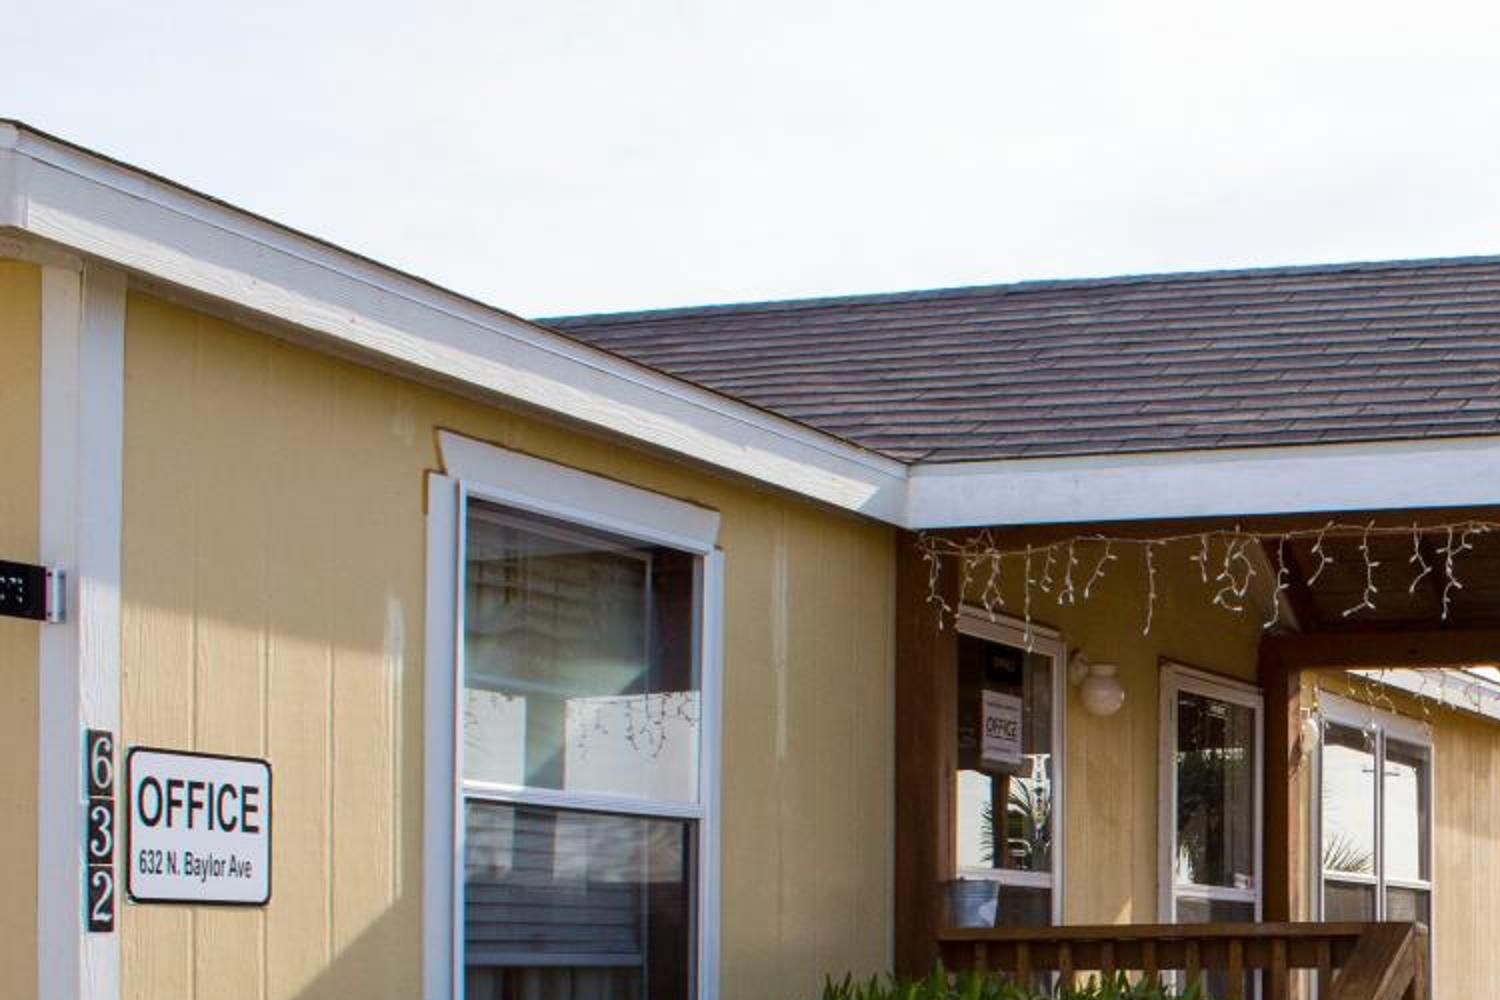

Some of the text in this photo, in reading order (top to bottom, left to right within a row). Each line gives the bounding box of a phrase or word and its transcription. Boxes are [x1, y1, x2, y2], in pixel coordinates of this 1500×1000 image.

[90, 737, 113, 922] 632
[137, 775, 260, 834] OFFICE
[139, 849, 252, 882] 632 N. Baylor Ave
